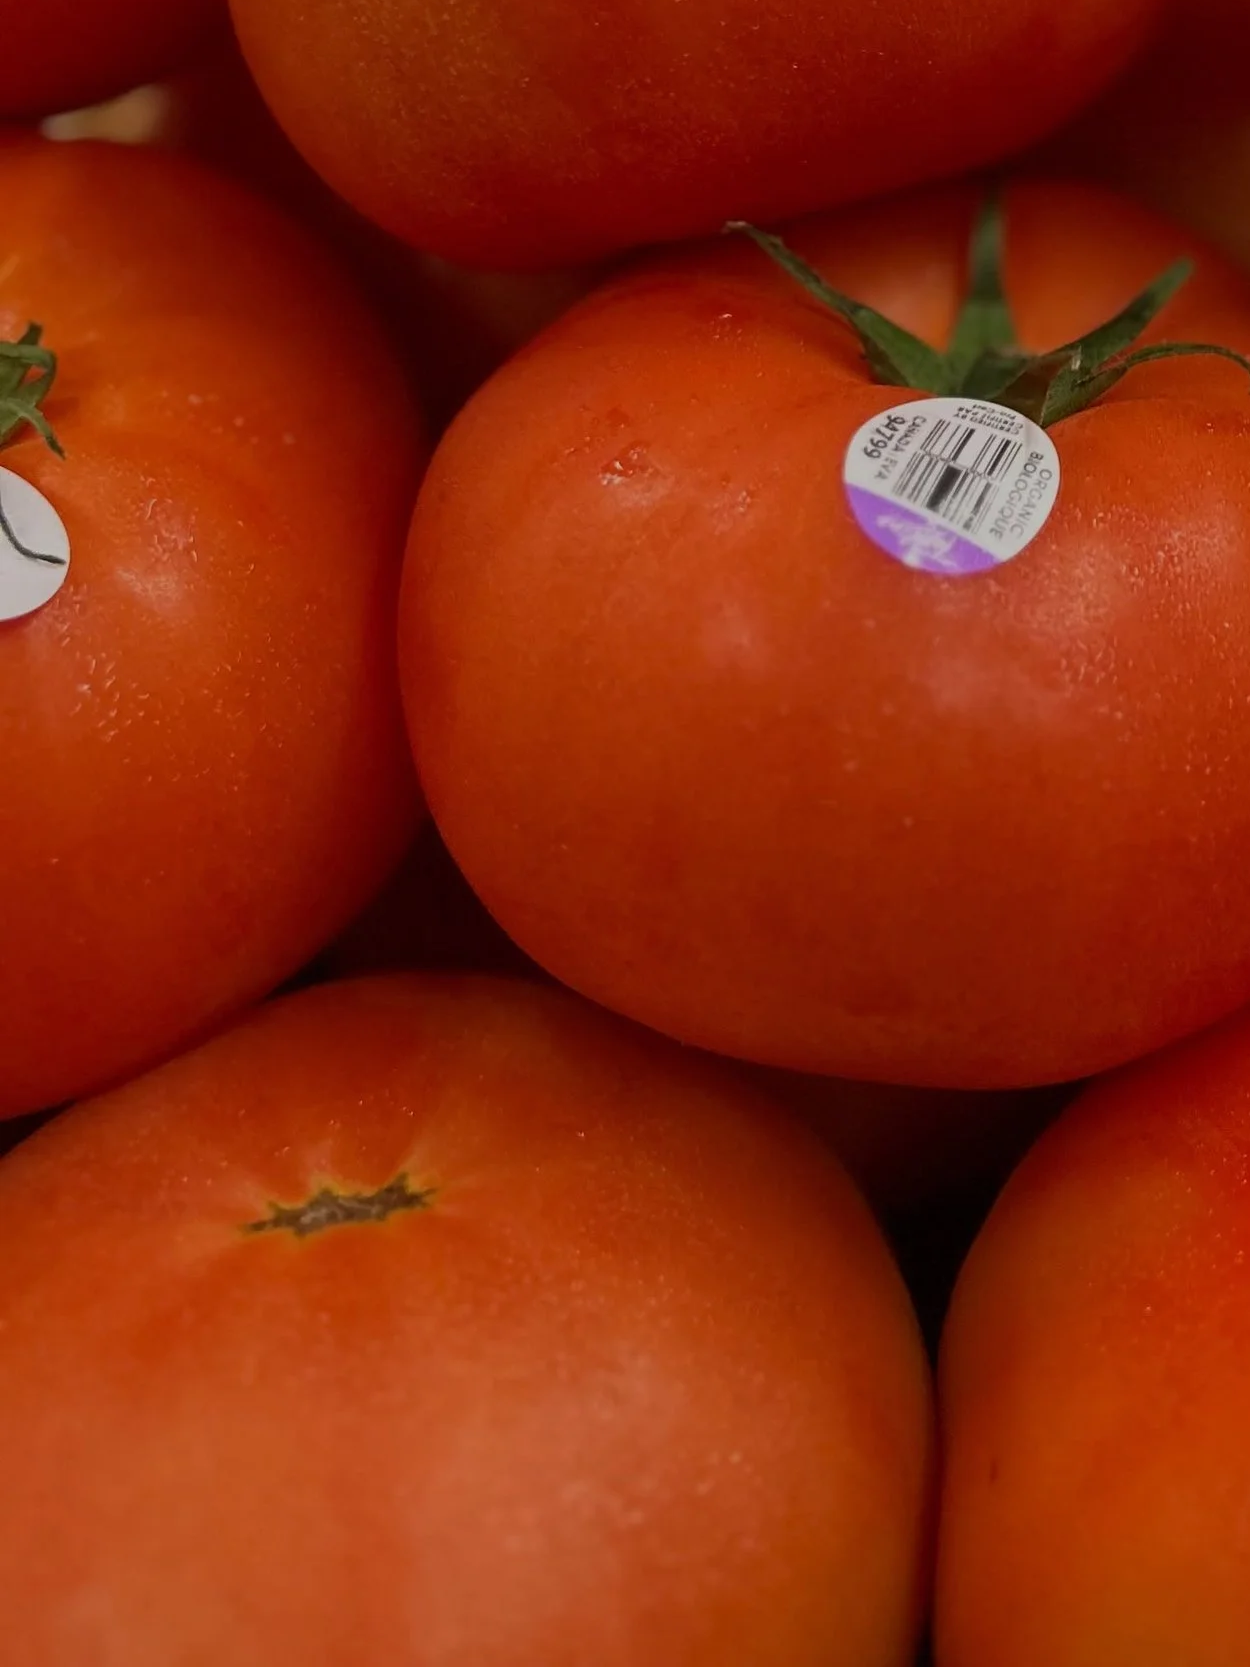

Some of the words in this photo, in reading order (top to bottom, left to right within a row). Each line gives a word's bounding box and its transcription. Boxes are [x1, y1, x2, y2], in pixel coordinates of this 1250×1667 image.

[863, 413, 906, 460] 94799
[892, 414, 927, 455] CANADA
[874, 456, 898, 480] EVA
[988, 450, 1043, 540] BIOLOGIQUE
[1009, 468, 1053, 538] ORGANIC
